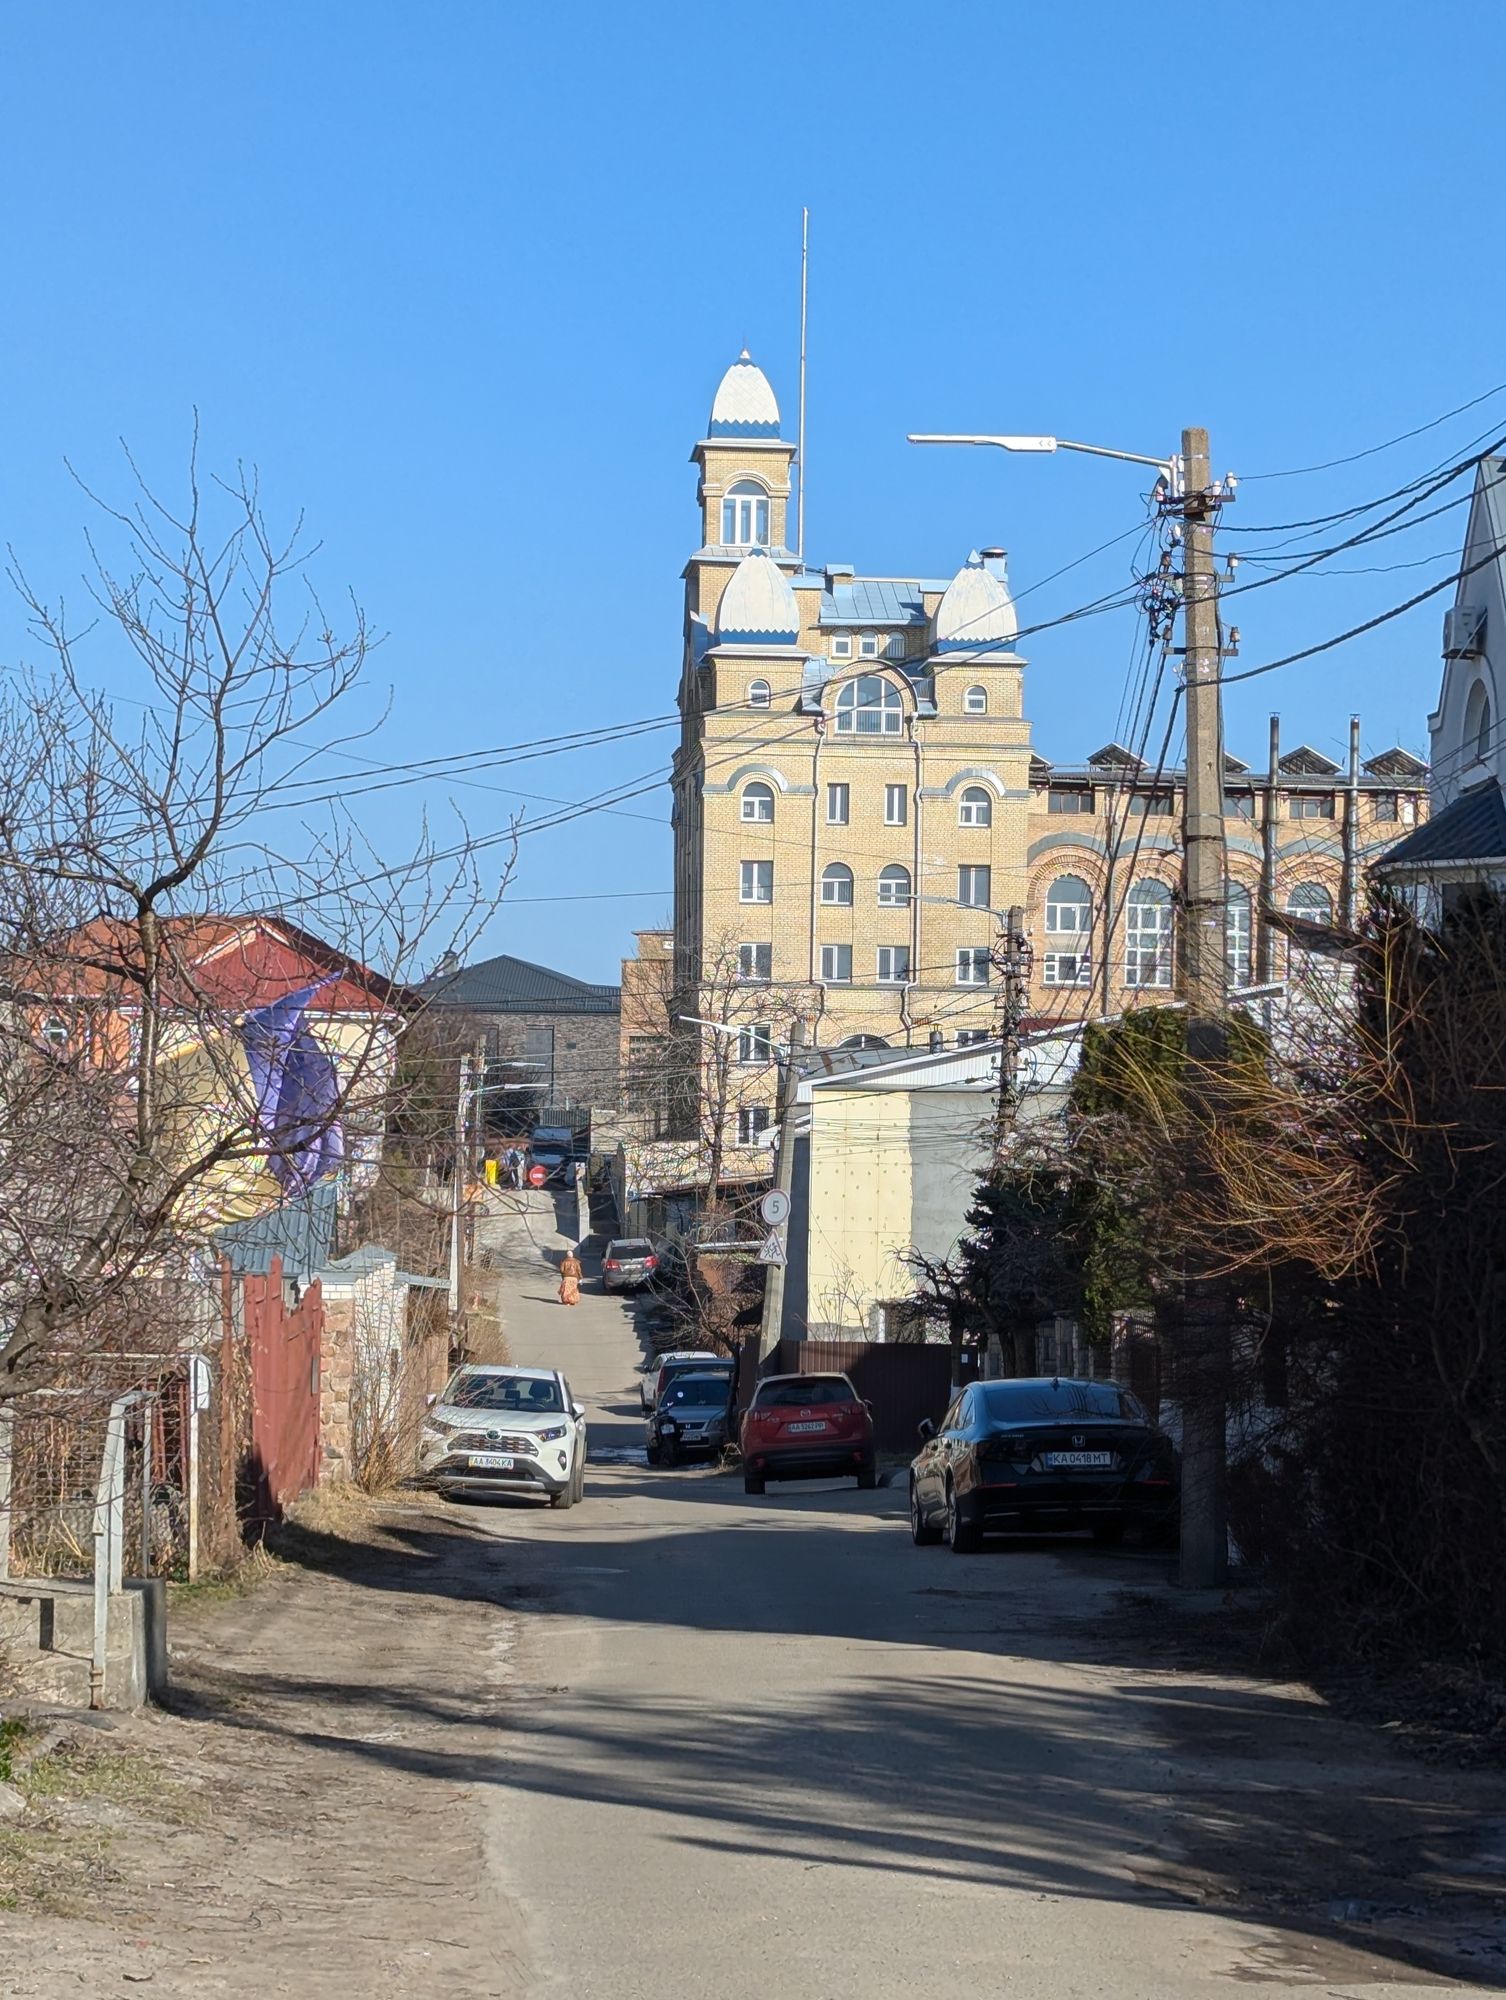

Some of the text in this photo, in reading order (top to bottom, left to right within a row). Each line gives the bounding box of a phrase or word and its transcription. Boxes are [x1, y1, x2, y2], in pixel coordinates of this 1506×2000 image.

[772, 1200, 780, 1214] 5
[1053, 1453, 1108, 1464] KA 0418 MT
